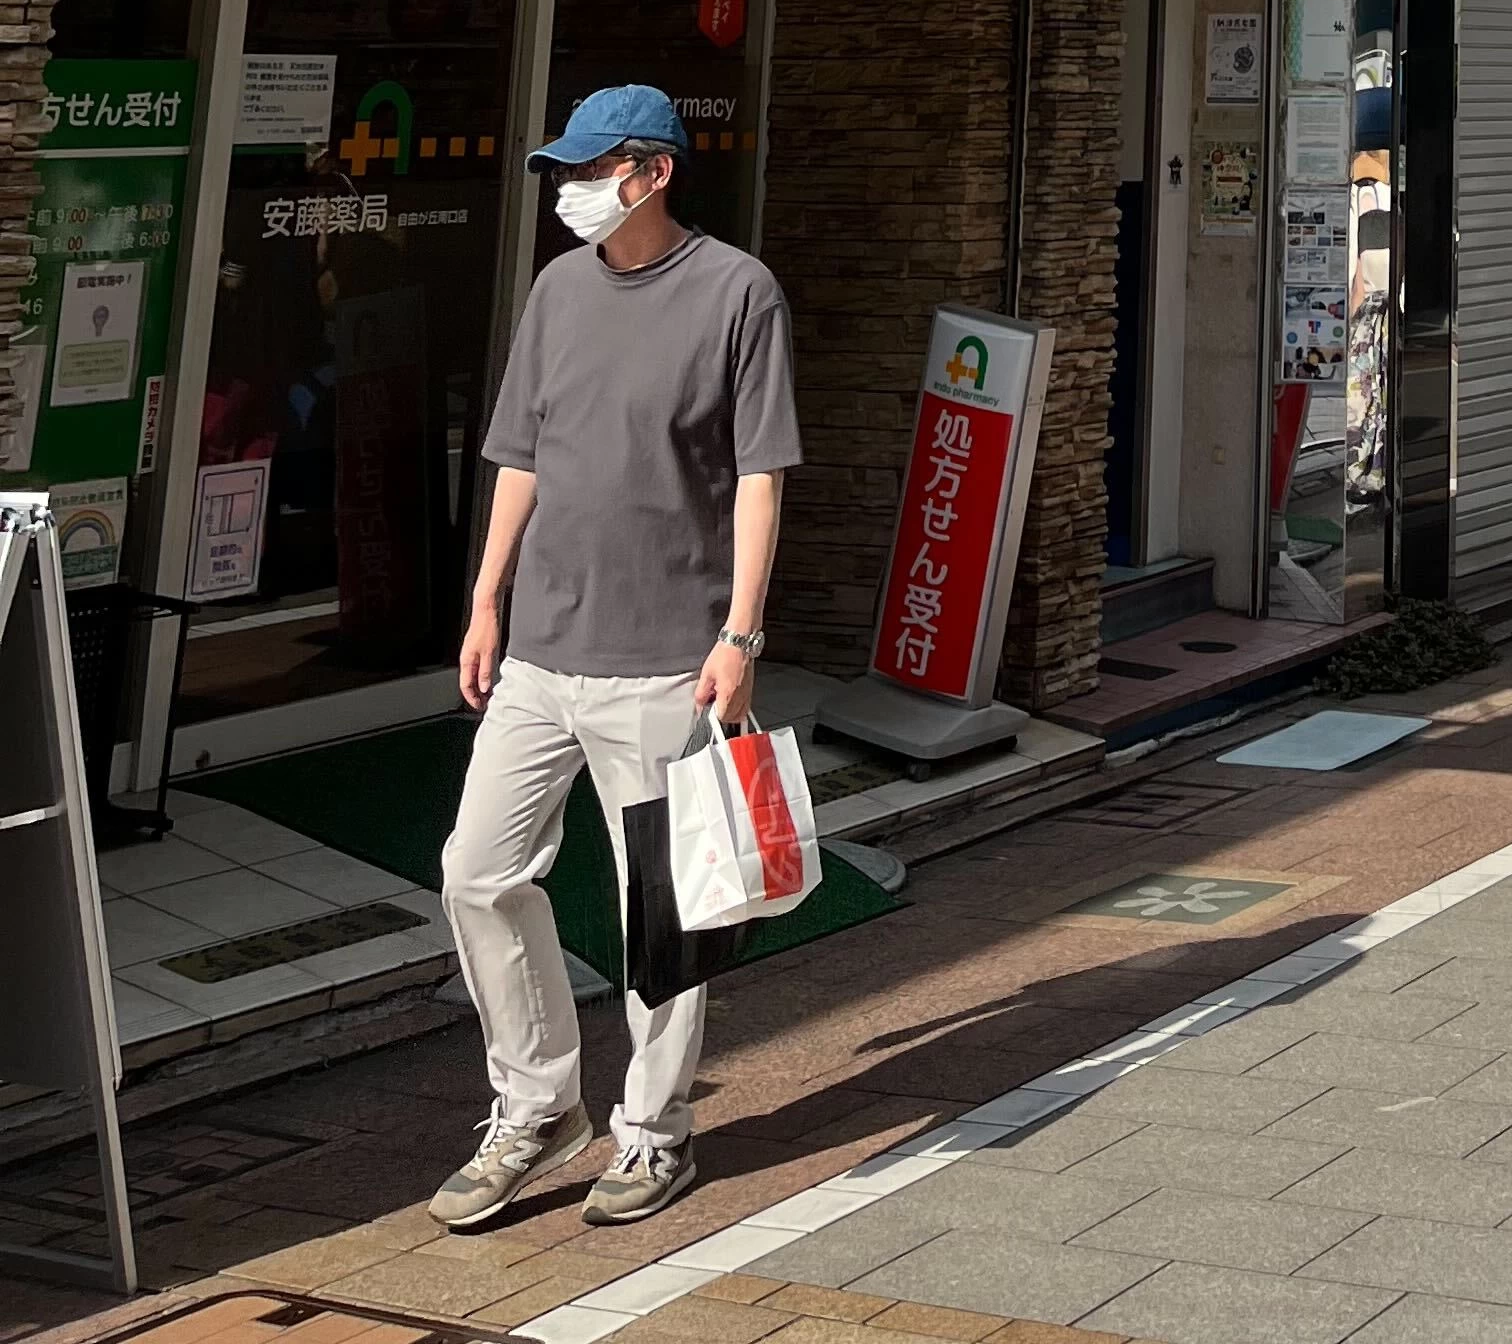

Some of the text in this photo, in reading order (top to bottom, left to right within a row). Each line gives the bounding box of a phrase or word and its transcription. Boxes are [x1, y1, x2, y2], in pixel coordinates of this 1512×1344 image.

[673, 96, 737, 121] rmacy
[262, 194, 388, 239] 安藤薬局
[895, 408, 974, 677] 処方せん受付
